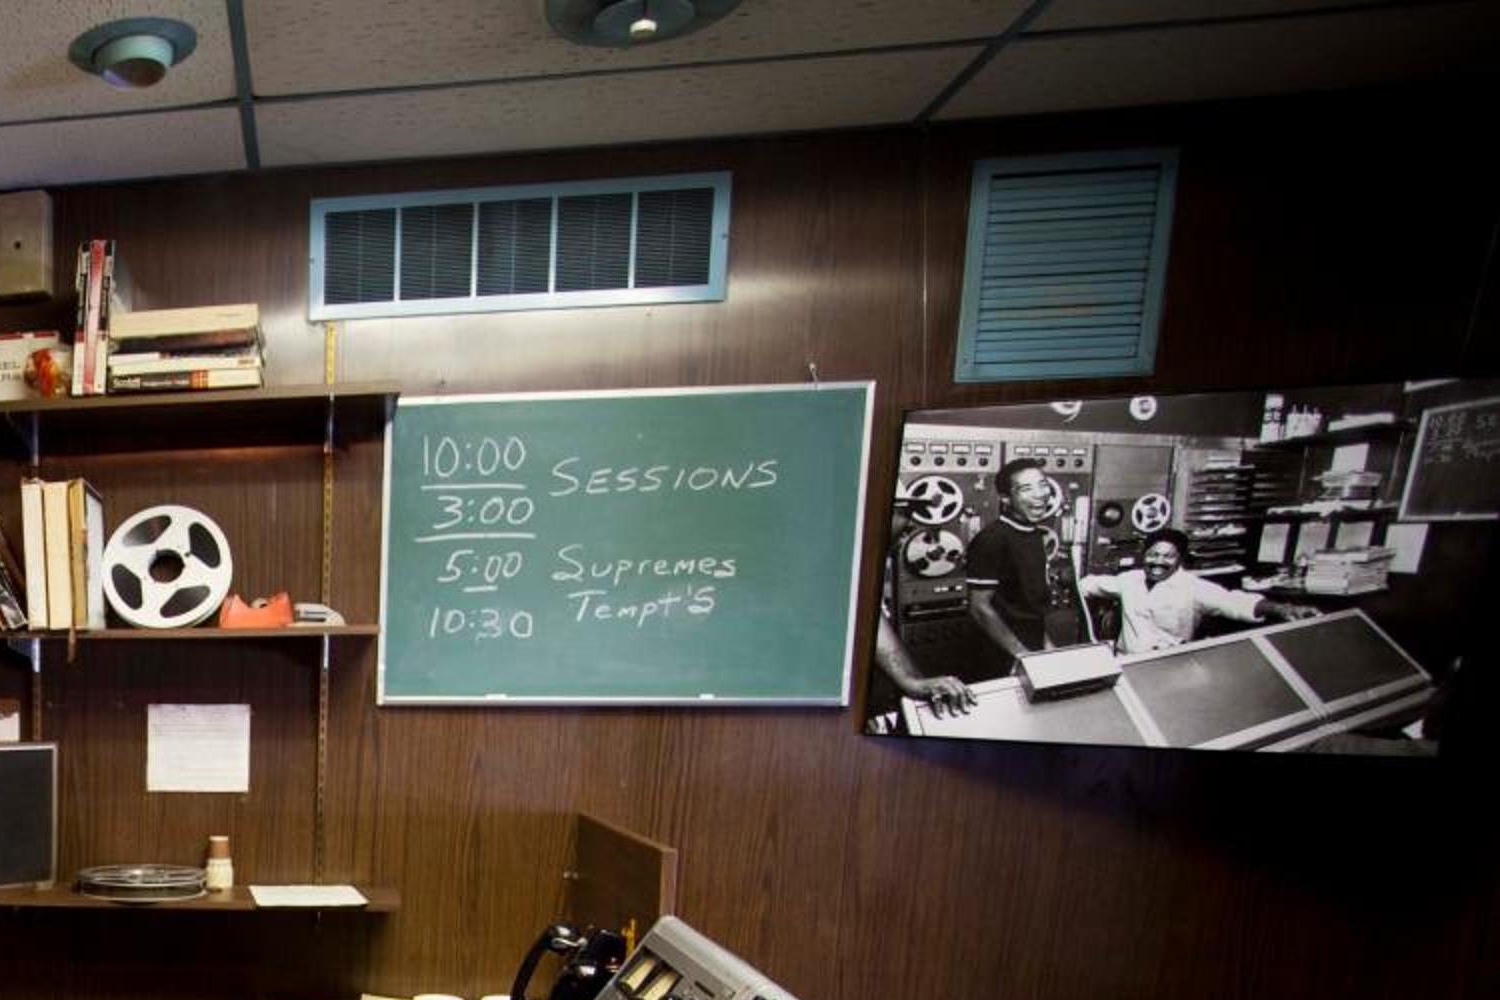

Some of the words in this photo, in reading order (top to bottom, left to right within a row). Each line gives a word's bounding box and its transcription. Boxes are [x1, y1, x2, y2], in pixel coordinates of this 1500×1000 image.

[423, 435, 526, 477] 10:00
[548, 457, 779, 497] SESSIONS
[433, 496, 534, 530] 3:00
[437, 549, 522, 583] 5:00
[551, 544, 738, 587] Supremes
[429, 607, 534, 641] 10:30
